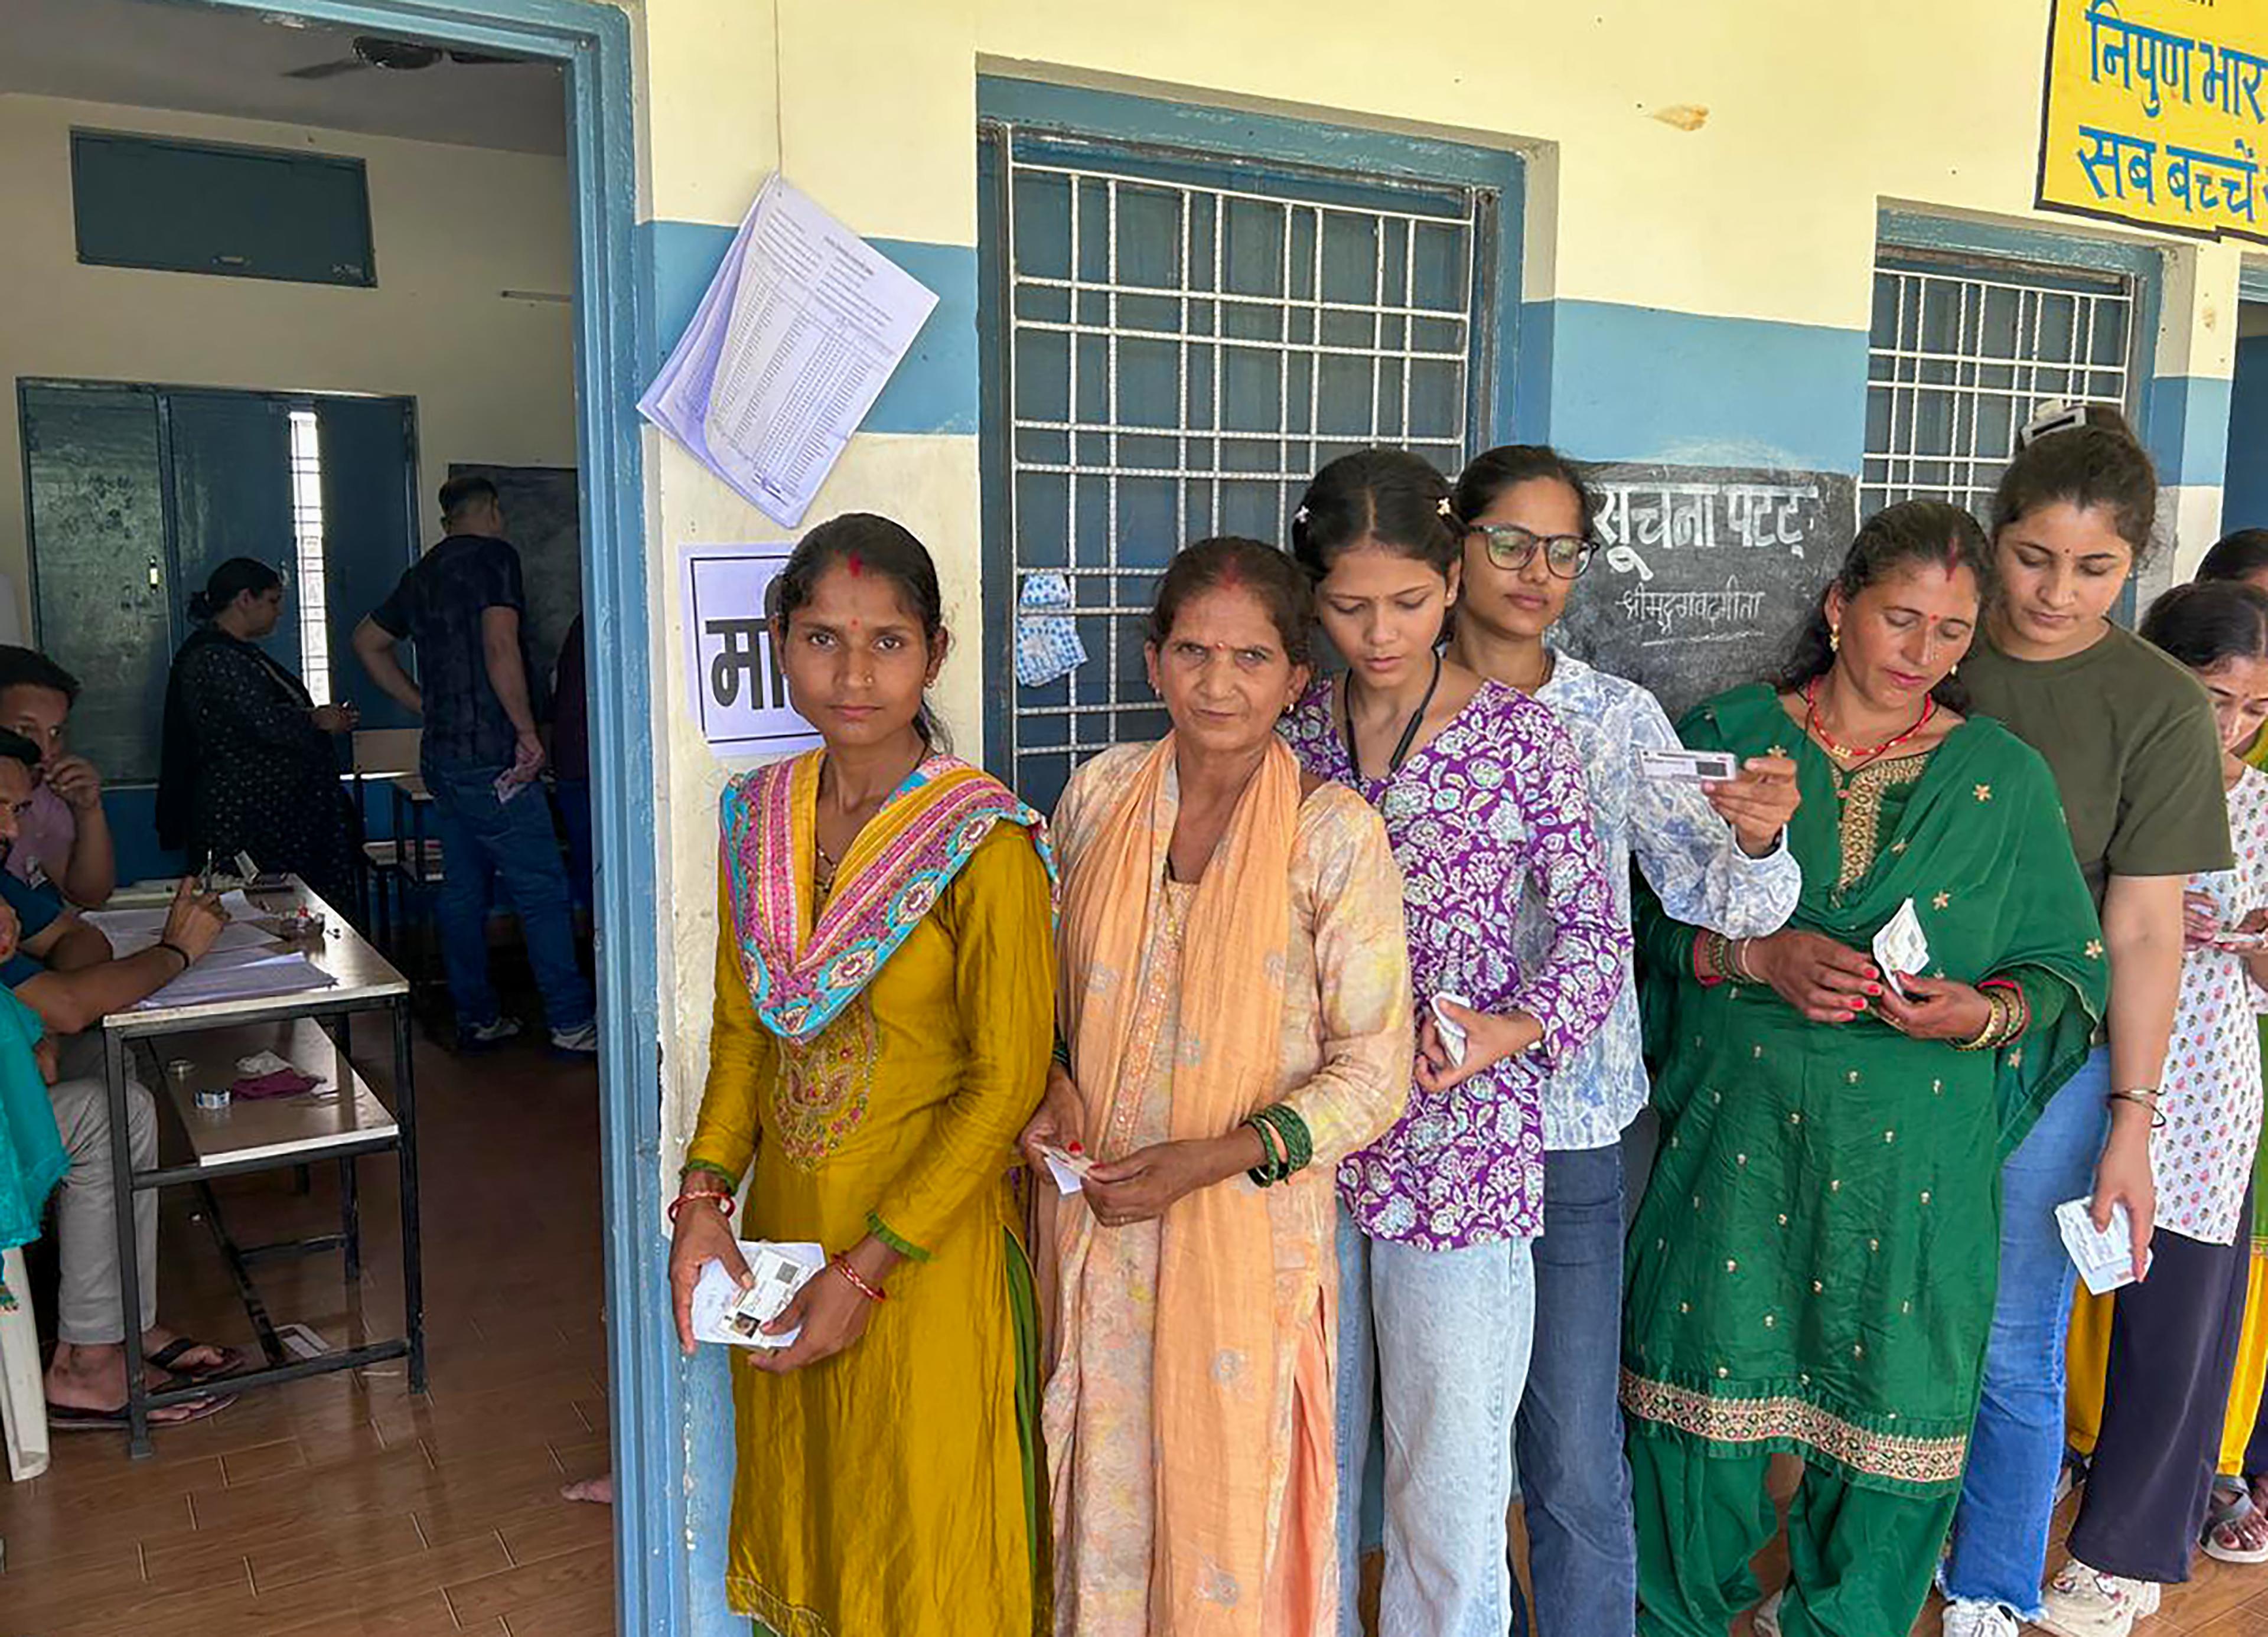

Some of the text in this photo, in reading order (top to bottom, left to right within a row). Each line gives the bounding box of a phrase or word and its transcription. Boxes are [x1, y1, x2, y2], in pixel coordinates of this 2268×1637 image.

[2085, 0, 2195, 118] निपुण
[2077, 124, 2157, 206] सब
[1585, 481, 1721, 581] सूचना
